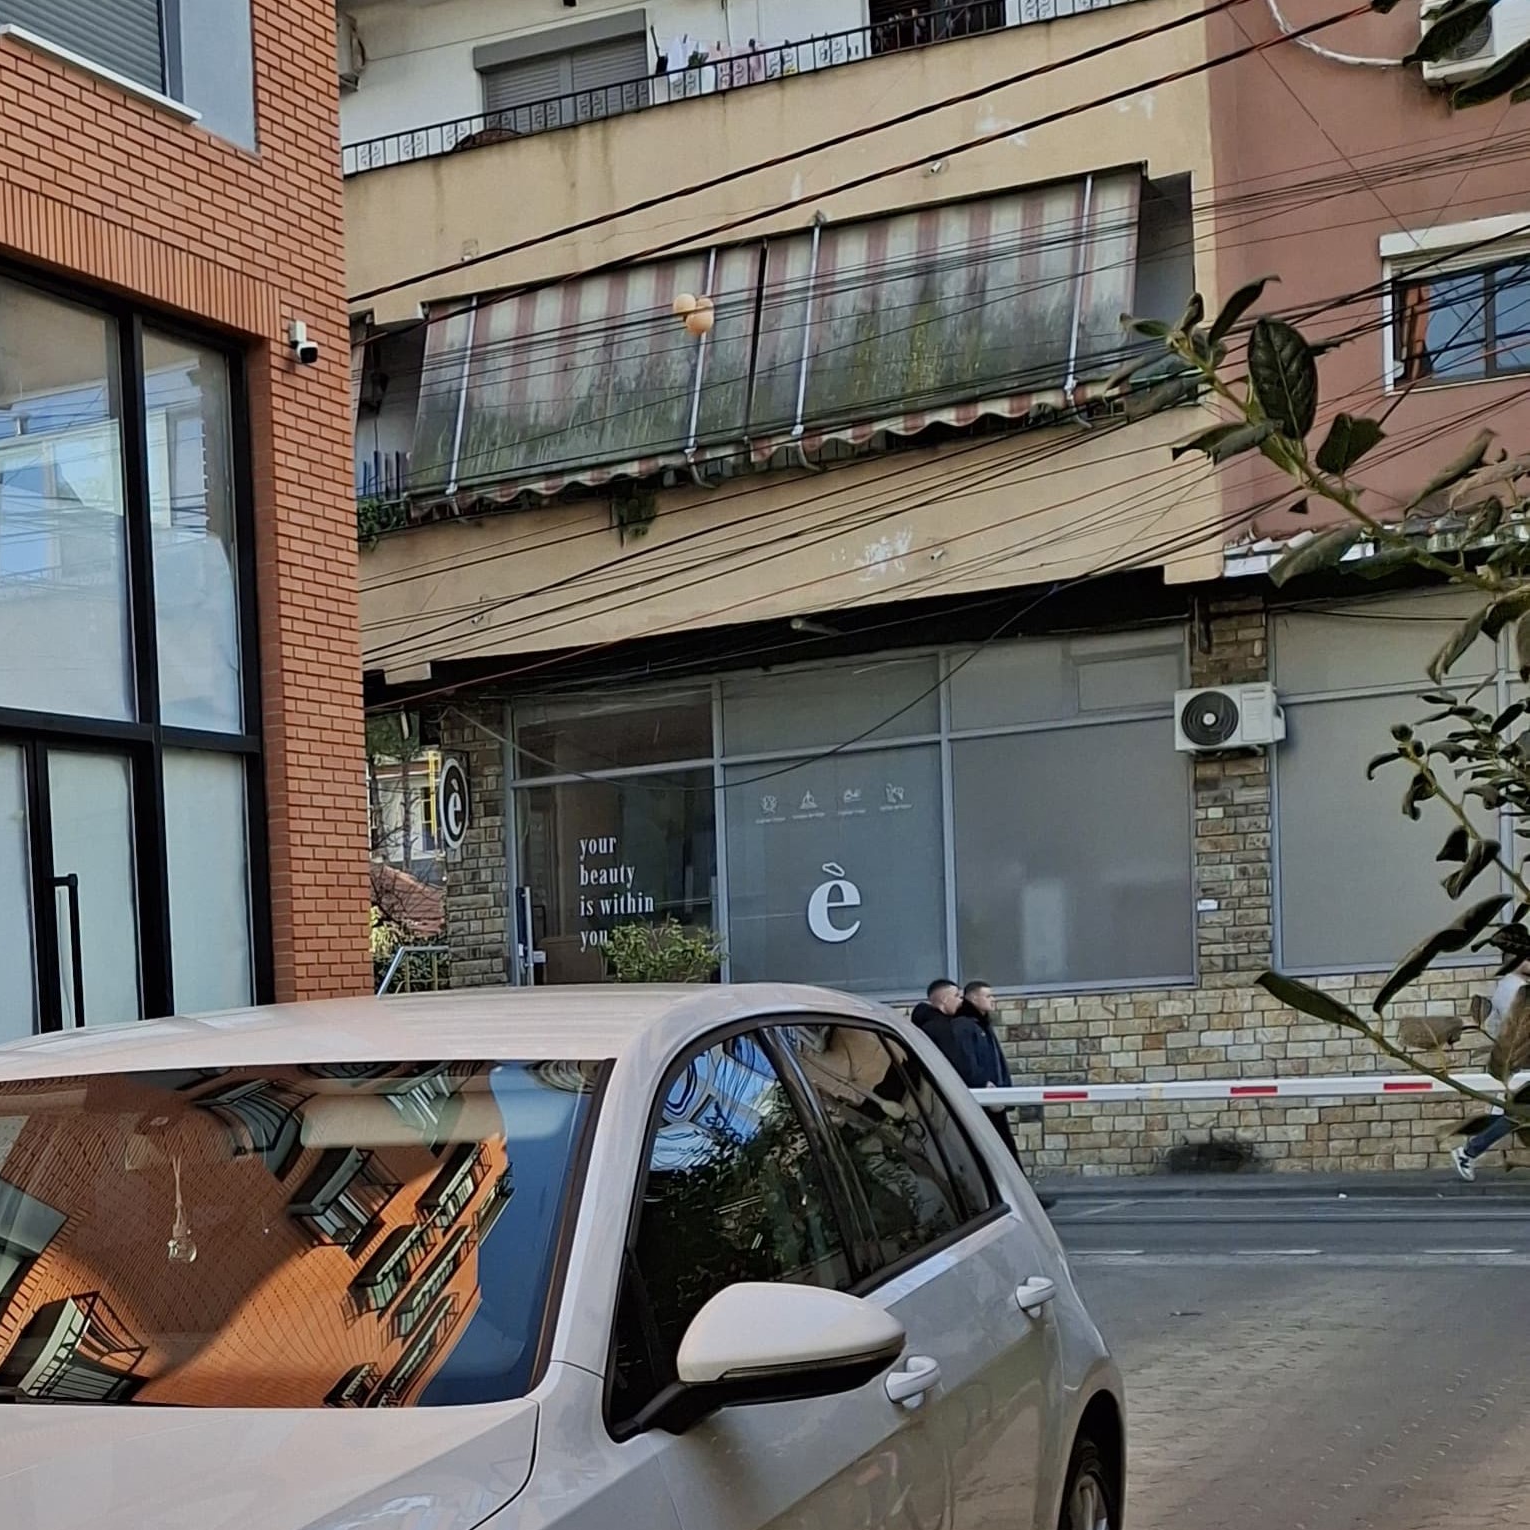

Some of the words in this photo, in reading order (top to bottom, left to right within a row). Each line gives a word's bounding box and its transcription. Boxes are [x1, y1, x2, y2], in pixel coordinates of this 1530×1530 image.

[579, 836, 617, 860] your
[579, 863, 636, 887] beauty
[579, 895, 594, 917] is
[599, 891, 655, 917] within
